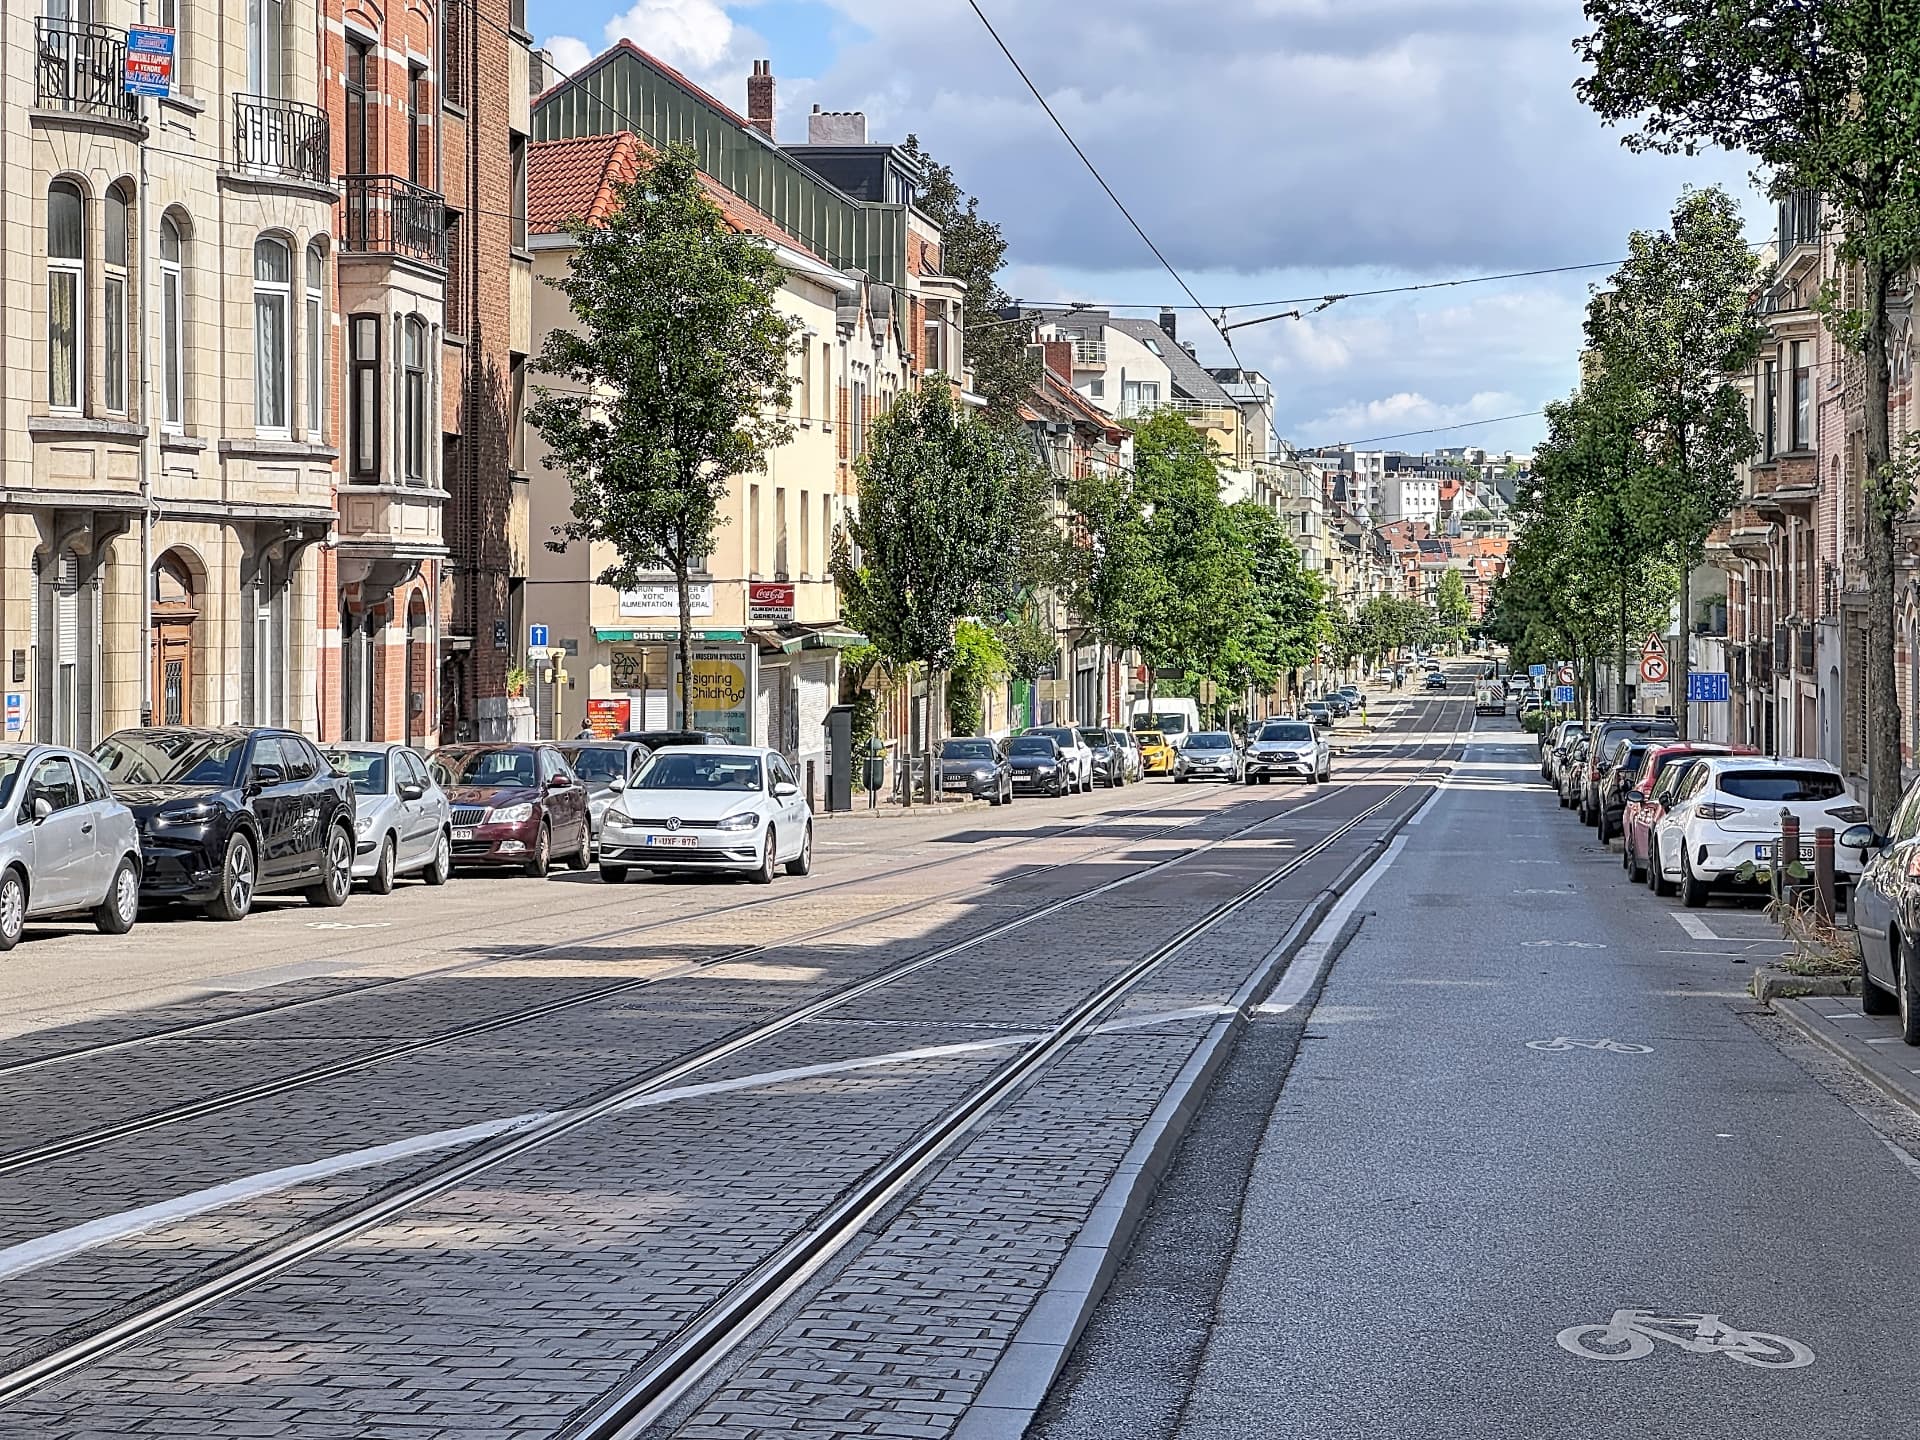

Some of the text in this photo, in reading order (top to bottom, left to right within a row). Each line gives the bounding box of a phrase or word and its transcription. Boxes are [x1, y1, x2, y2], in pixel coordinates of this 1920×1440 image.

[140, 65, 162, 74] VENDRE
[756, 588, 785, 599] Coca-Cola
[621, 600, 673, 608] ALIMENTATION
[633, 632, 663, 640] DISTRI
[676, 672, 732, 686] Dsigning
[692, 687, 745, 702] Childhood
